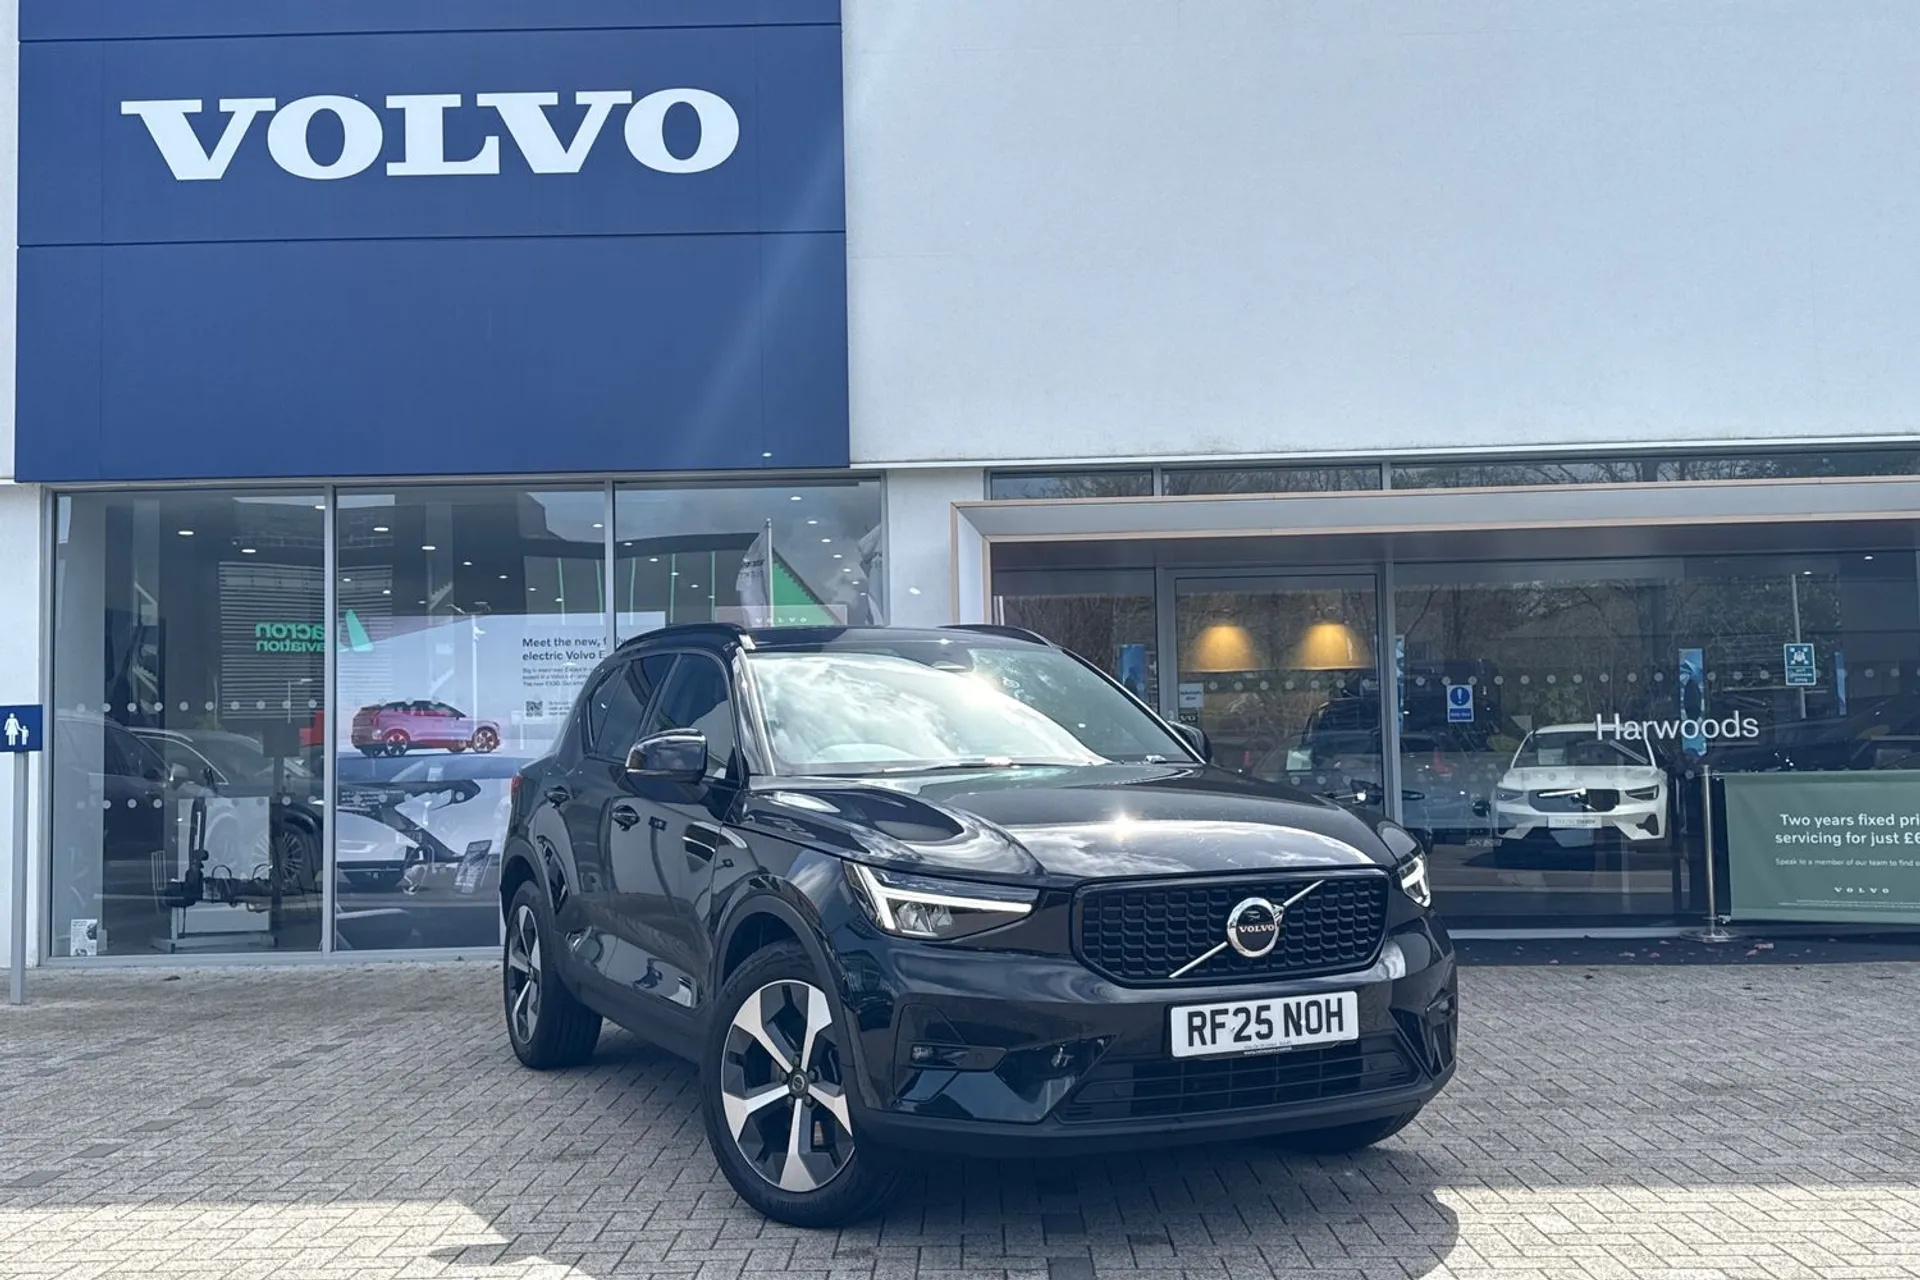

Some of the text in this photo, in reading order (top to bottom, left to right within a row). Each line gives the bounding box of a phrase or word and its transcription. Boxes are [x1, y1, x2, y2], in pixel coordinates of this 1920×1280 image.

[121, 88, 740, 180] VOLVO
[522, 638, 551, 647] Meet
[554, 637, 572, 646] the
[574, 639, 600, 647] new,
[522, 651, 563, 661] electric
[565, 651, 596, 660] Volvo
[1596, 710, 1760, 741] Harwoods
[1780, 813, 1811, 826] Two
[1814, 816, 1855, 829] years
[1858, 813, 1895, 826] fixed
[1775, 832, 1842, 847] servicing
[1845, 831, 1867, 844] for
[1870, 832, 1900, 848] just
[1814, 858, 1845, 866] member
[1845, 858, 1854, 866] of
[1868, 859, 1888, 867] team
[1889, 859, 1898, 867] to
[1899, 859, 1914, 867] find
[1833, 886, 1890, 894] VOLVO
[1238, 924, 1276, 933] VOLVO
[1187, 997, 1344, 1047] RF25 NOH
